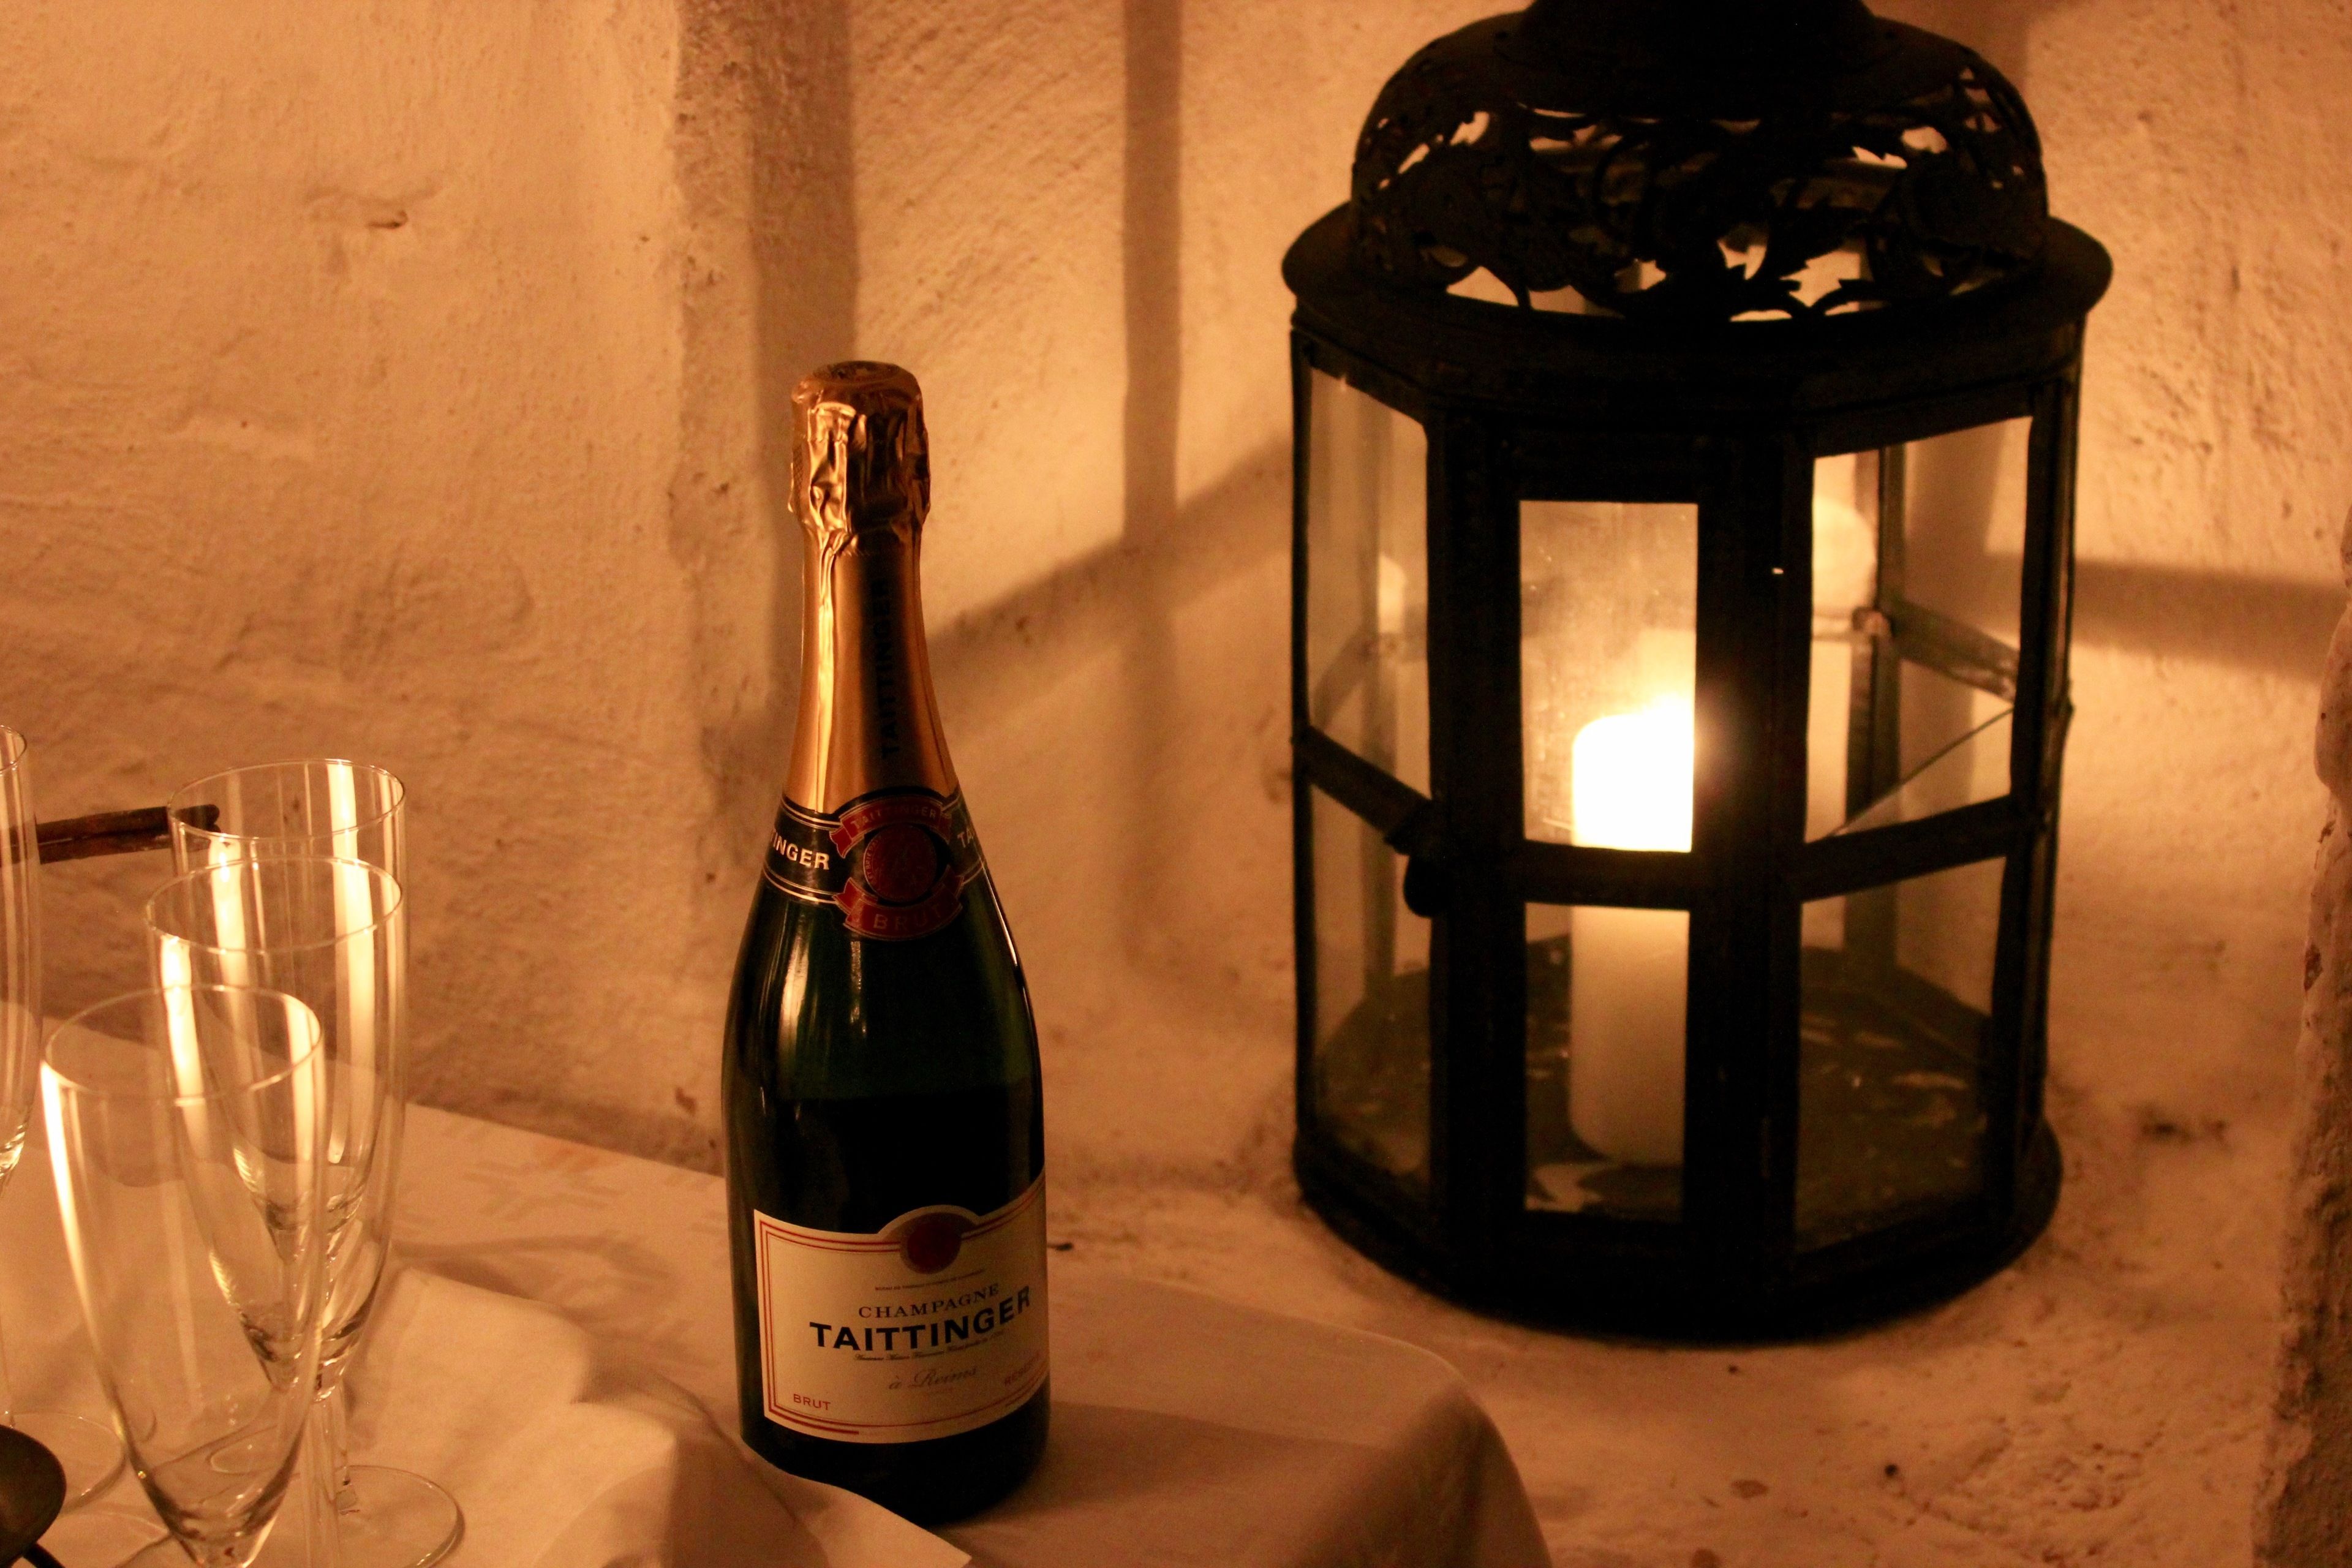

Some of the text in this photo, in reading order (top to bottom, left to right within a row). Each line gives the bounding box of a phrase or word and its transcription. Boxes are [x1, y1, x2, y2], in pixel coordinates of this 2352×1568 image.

[872, 578, 900, 760] TAITTINGER
[873, 903, 941, 931] BRUT
[859, 1283, 998, 1318] CHAMPAGNE
[810, 1286, 1030, 1351] TAITTINGER
[794, 1394, 831, 1411] BRUT
